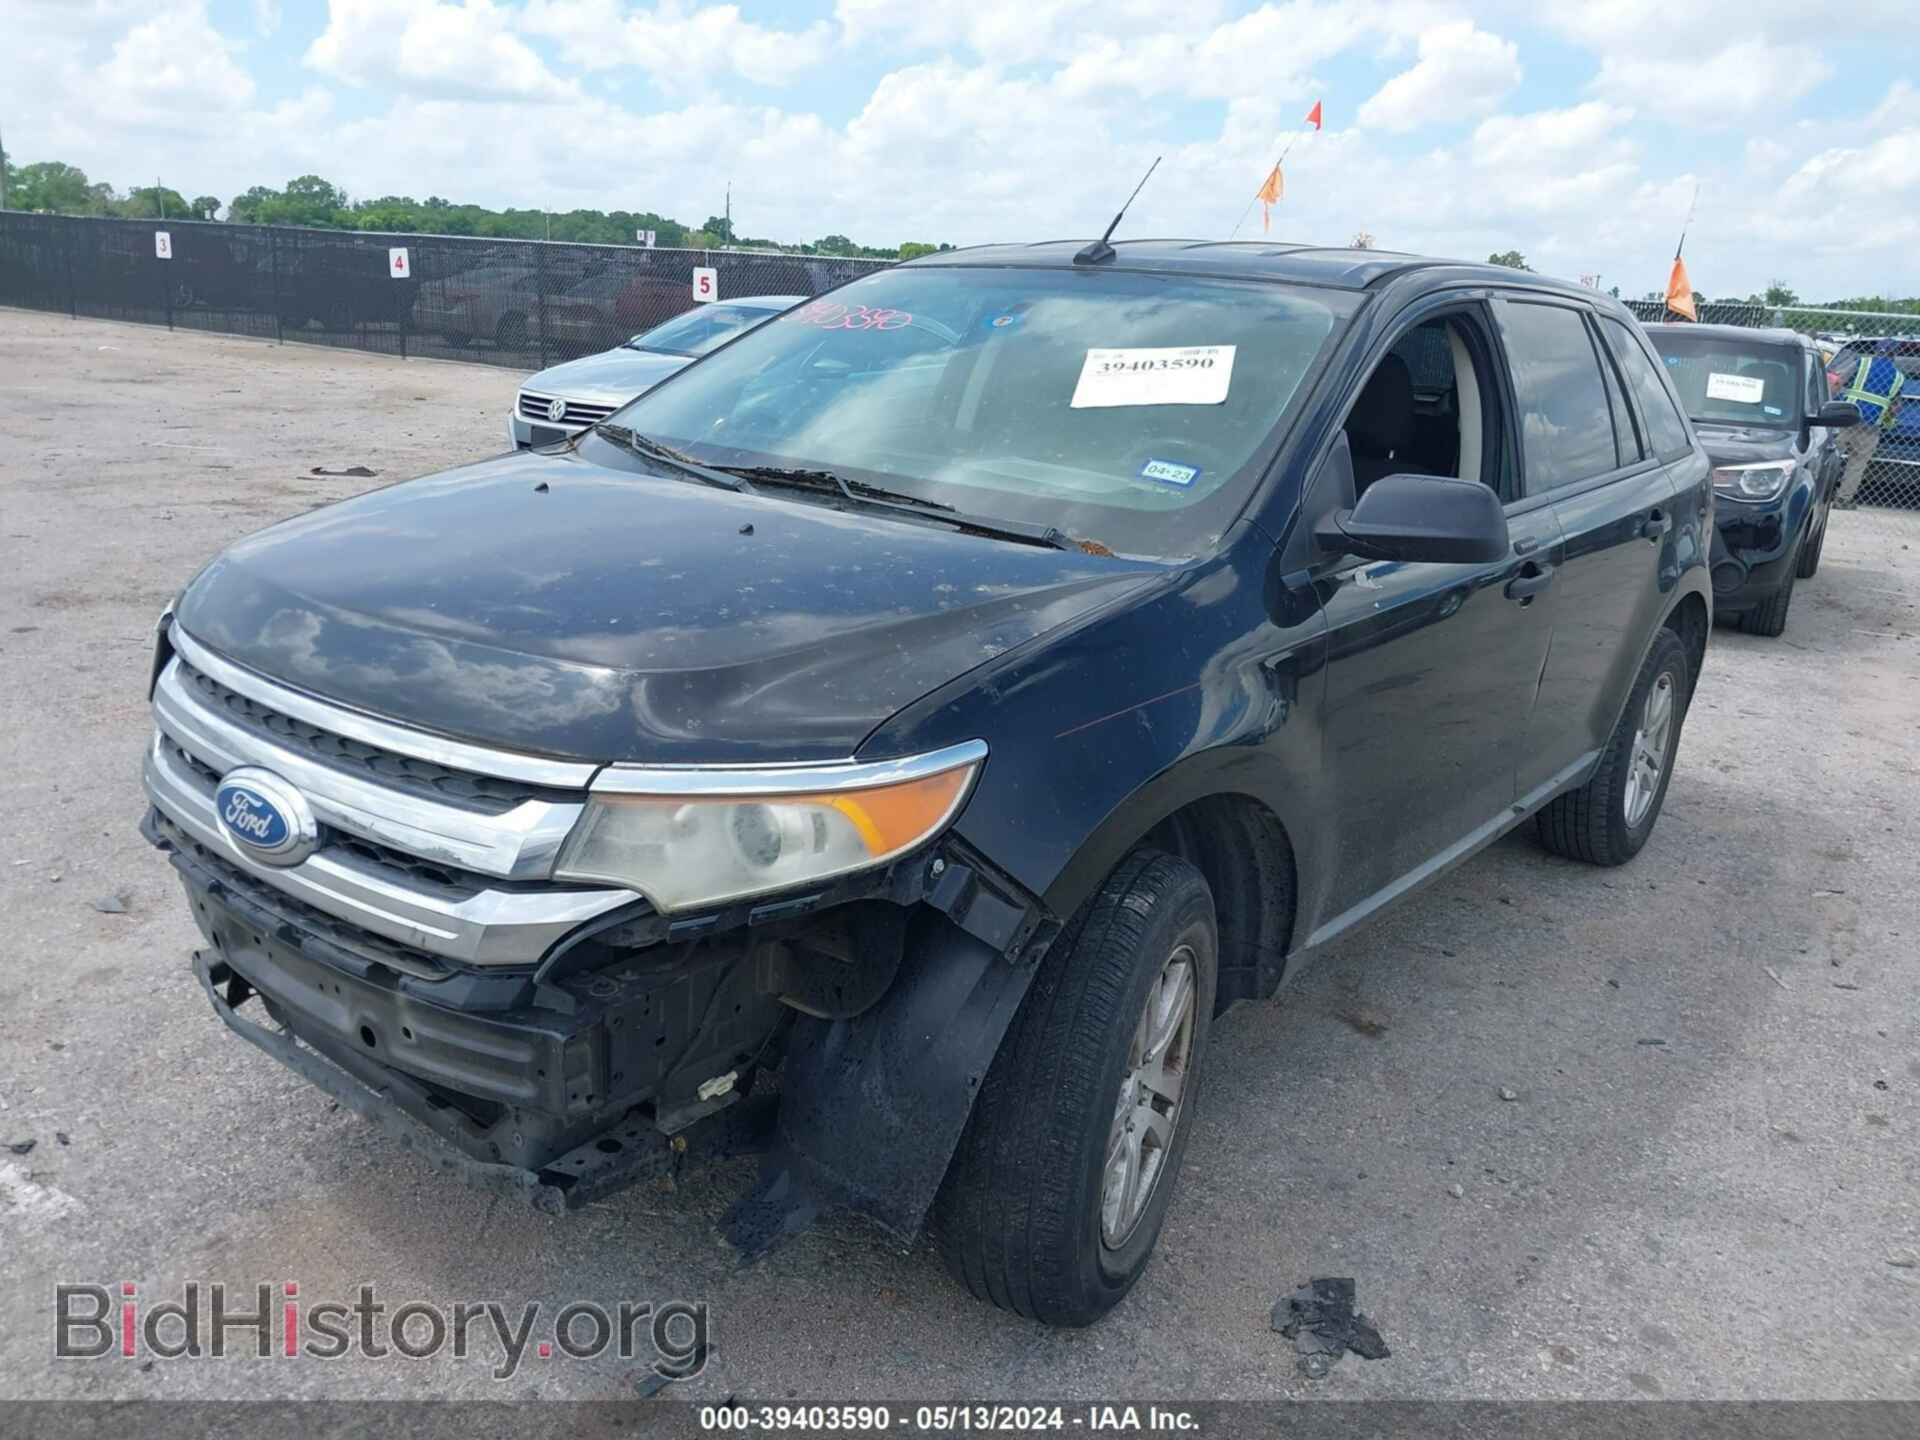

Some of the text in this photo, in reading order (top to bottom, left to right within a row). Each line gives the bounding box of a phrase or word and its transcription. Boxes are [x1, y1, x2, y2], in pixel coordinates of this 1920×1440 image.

[159, 237, 168, 252] 3
[394, 255, 404, 271] 4
[700, 276, 711, 294] 5
[1097, 358, 1215, 375] 39403590
[225, 790, 274, 838] Ford
